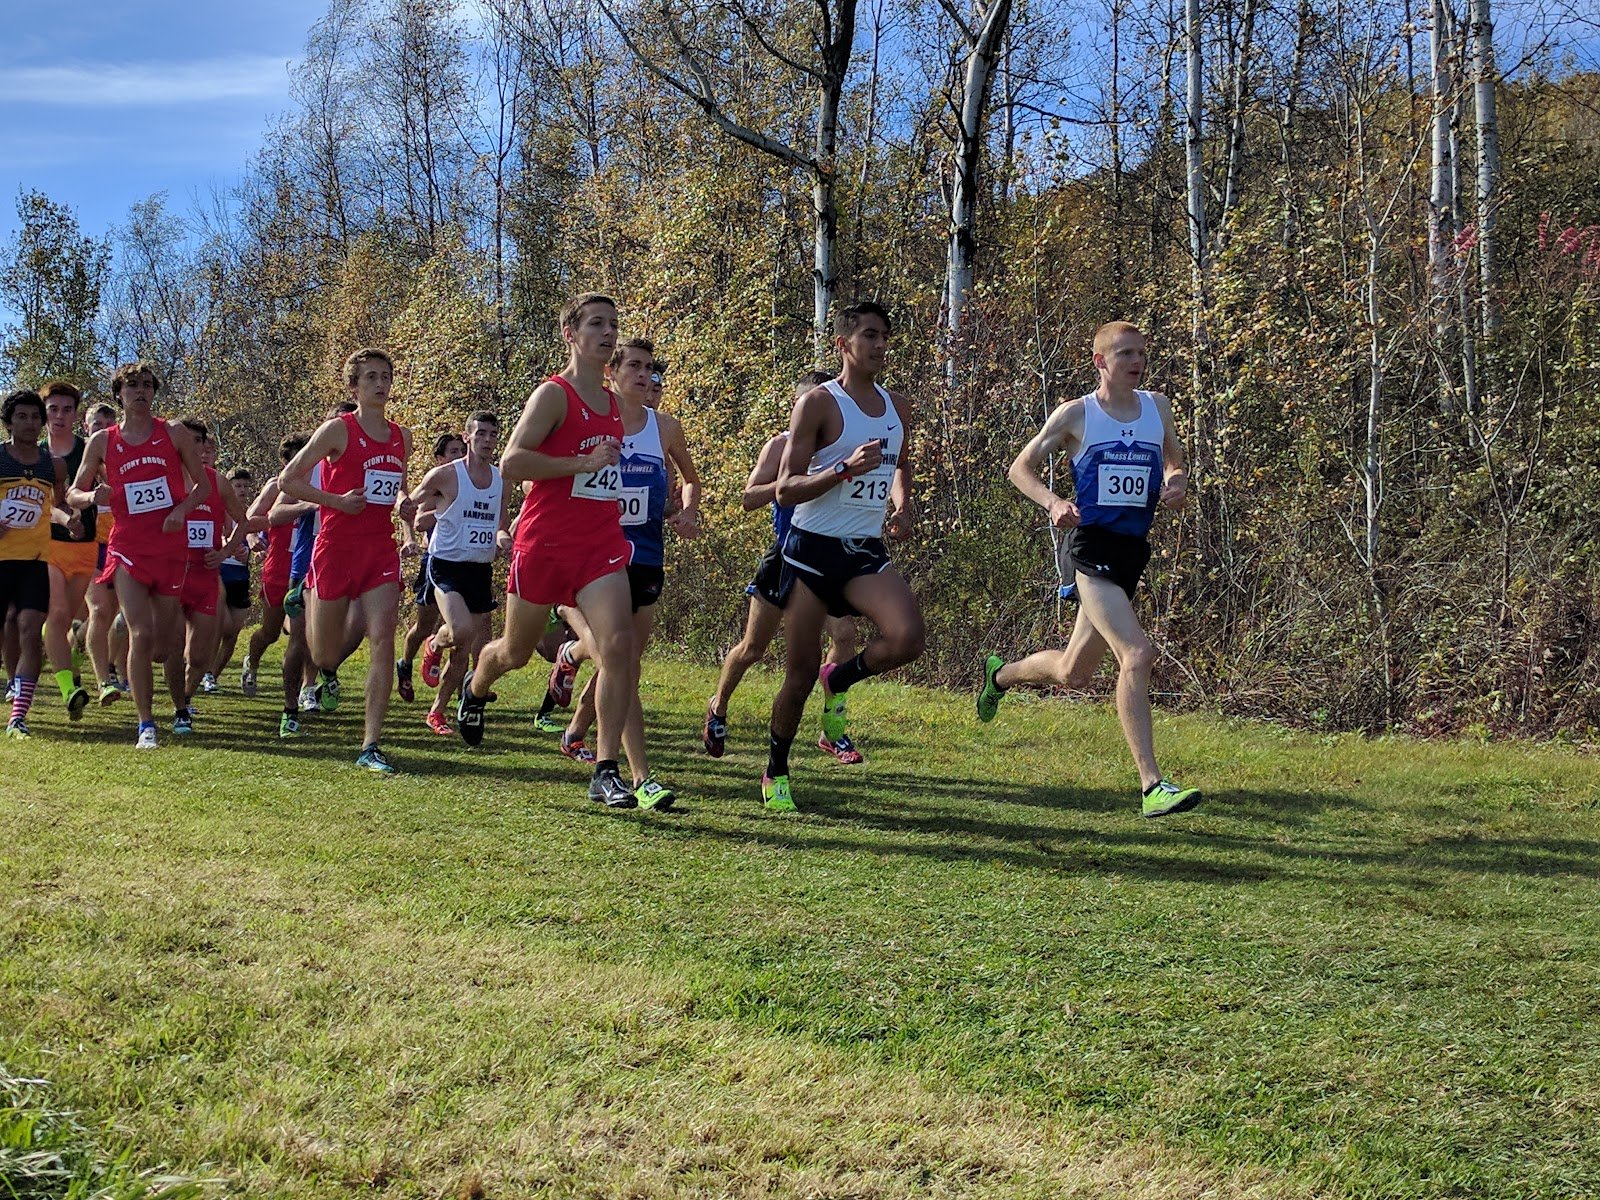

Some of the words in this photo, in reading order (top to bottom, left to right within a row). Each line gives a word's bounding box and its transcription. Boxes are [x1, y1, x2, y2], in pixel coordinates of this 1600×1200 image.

[119, 459, 140, 475] STONY
[142, 456, 167, 467] BROOK
[363, 455, 384, 470] STONY
[372, 479, 400, 497] 236
[584, 469, 618, 491] 242
[1108, 475, 1145, 496] 309
[7, 485, 45, 505] UMBC
[134, 486, 166, 506] 235
[851, 480, 888, 500] 213
[474, 500, 489, 510] NEW
[619, 498, 640, 516] 00
[5, 506, 36, 523] 270
[189, 527, 207, 541] 39
[469, 530, 493, 544] 209
